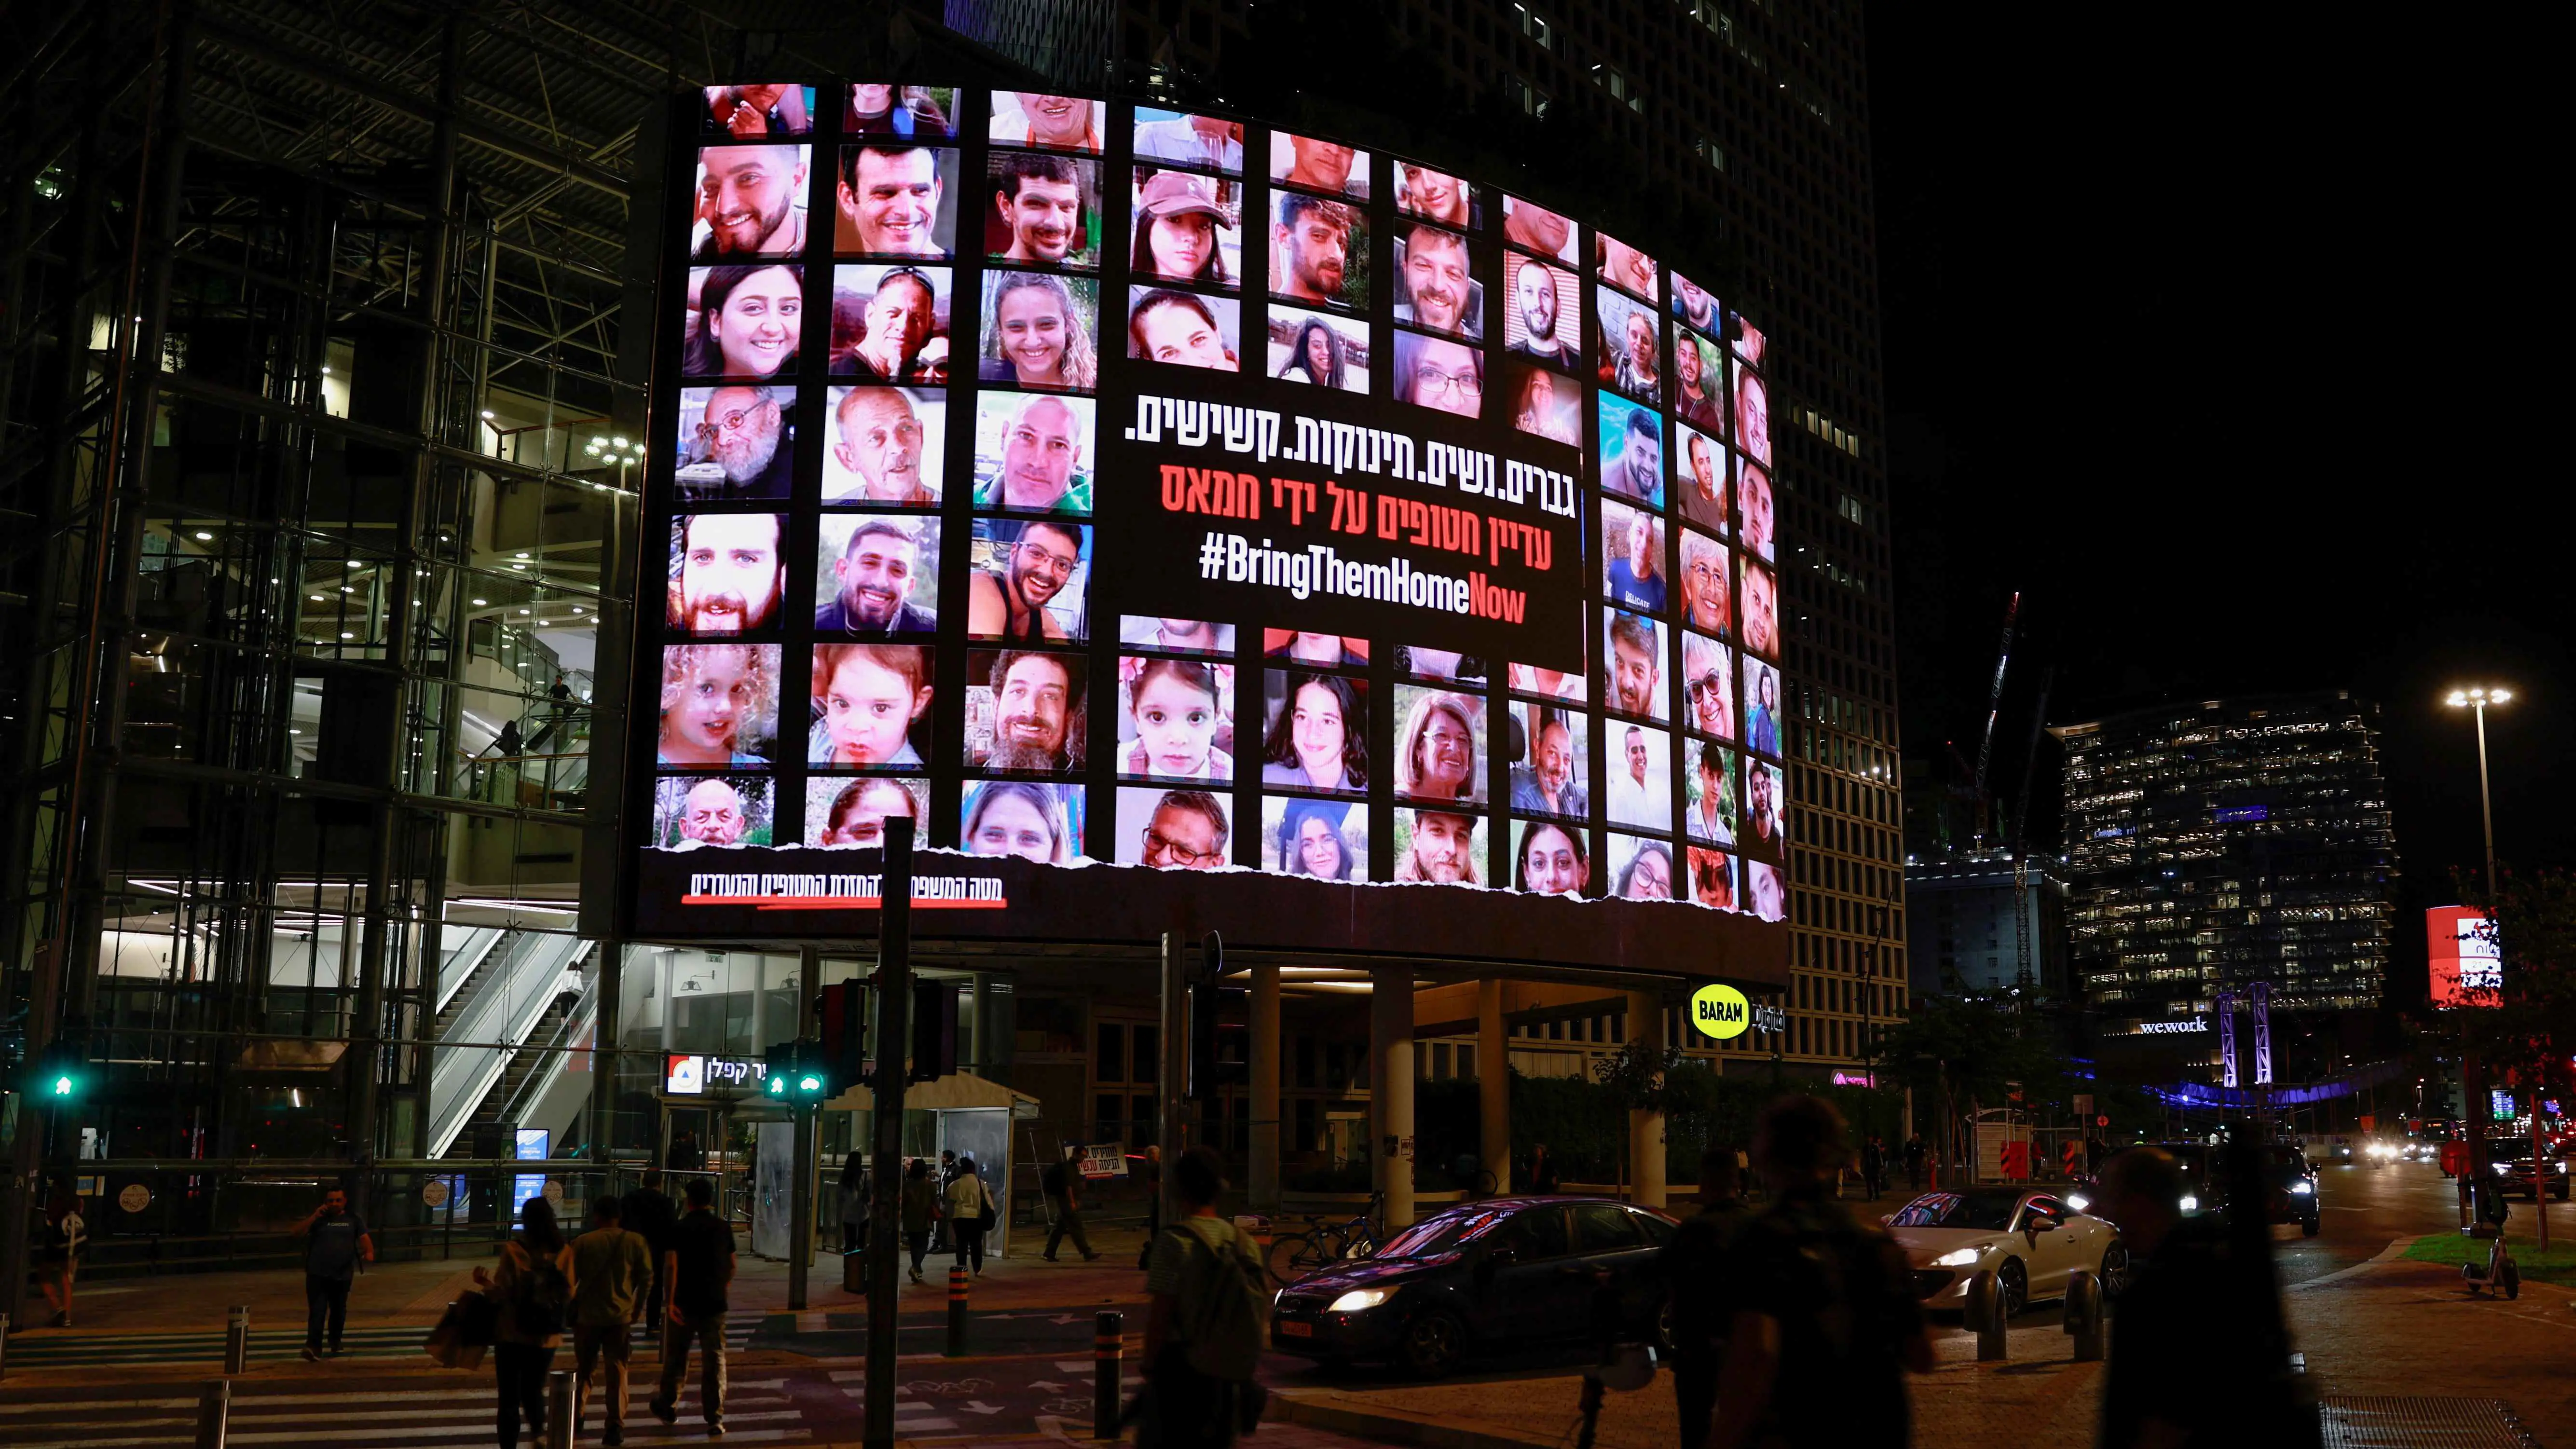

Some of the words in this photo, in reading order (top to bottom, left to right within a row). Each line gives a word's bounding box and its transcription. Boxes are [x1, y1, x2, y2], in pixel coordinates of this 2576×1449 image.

[1160, 465, 1260, 519] חמאס
[1271, 478, 1316, 525] ידי
[1326, 481, 1367, 534] על
[1378, 494, 1480, 556] חטופים
[1488, 517, 1551, 570] עדיין
[1199, 532, 1526, 624] #BringThemHomeNow
[690, 874, 758, 897] והנעדרים
[761, 874, 826, 898] החטופים
[969, 877, 1002, 901] מטה
[1699, 1000, 1742, 1022] BARAM
[2140, 1016, 2208, 1034] wework
[707, 1057, 748, 1085] קפלן
[1098, 1159, 1120, 1171] הביתה
